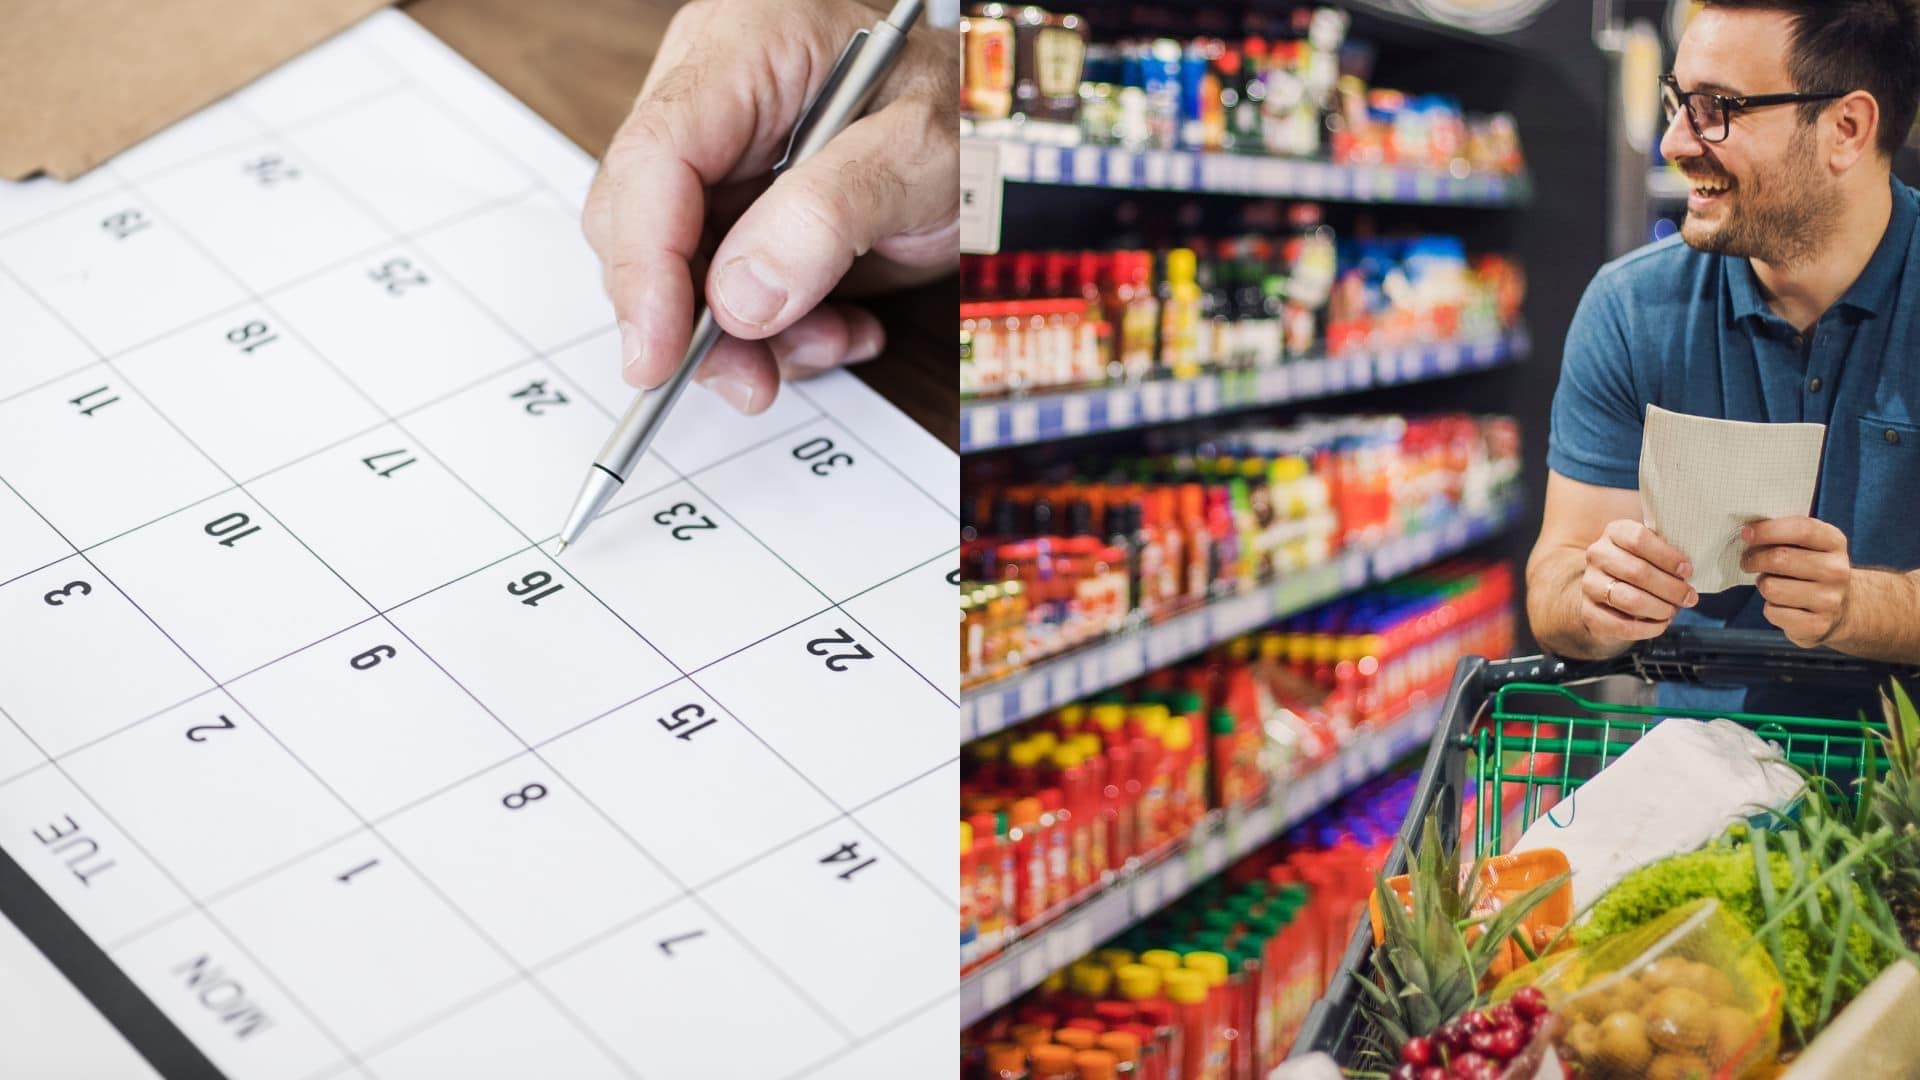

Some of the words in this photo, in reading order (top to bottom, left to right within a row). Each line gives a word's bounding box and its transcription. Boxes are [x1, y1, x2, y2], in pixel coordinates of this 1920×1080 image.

[100, 208, 151, 240] 19
[368, 257, 431, 296] 25
[226, 320, 279, 354] 18
[68, 384, 121, 418] 11
[509, 379, 571, 417] 24
[361, 448, 418, 479] 17
[792, 437, 854, 477] 30
[204, 511, 262, 548] 10
[653, 501, 719, 542] 23
[44, 580, 92, 606] 3
[506, 569, 564, 607] 16
[350, 644, 397, 671] 9
[806, 627, 875, 673] 22
[186, 714, 236, 743] 2
[657, 702, 718, 742] 15
[502, 783, 548, 811] 8
[31, 813, 117, 888] TUE
[819, 841, 878, 882] 14
[336, 858, 380, 885] 1
[657, 928, 707, 957] 7
[172, 952, 277, 1041] MON
